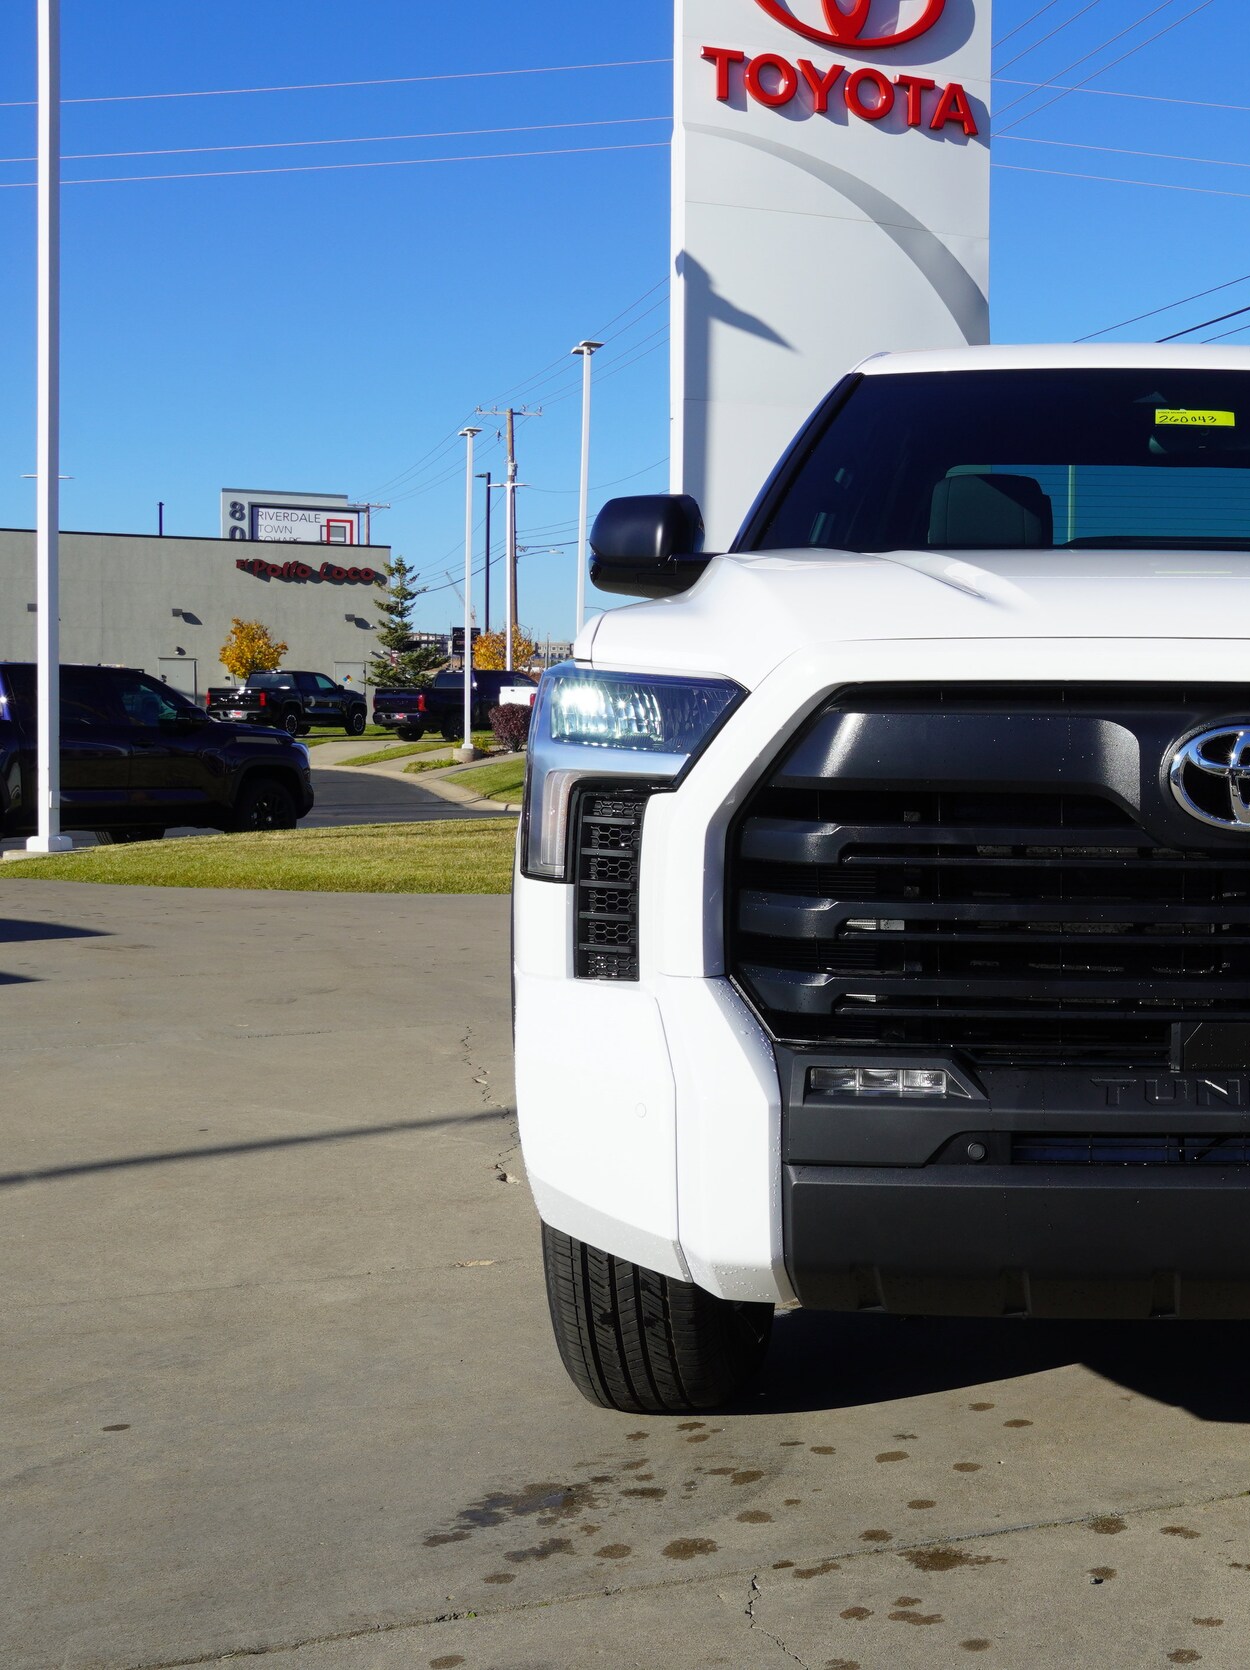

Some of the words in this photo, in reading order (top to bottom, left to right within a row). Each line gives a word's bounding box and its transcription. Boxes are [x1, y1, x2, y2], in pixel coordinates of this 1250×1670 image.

[700, 45, 979, 136] TOYOTA
[258, 511, 321, 523] RIVERDALE
[259, 525, 293, 534] TOWN
[252, 559, 312, 577] Pollo
[320, 562, 375, 580] Loco
